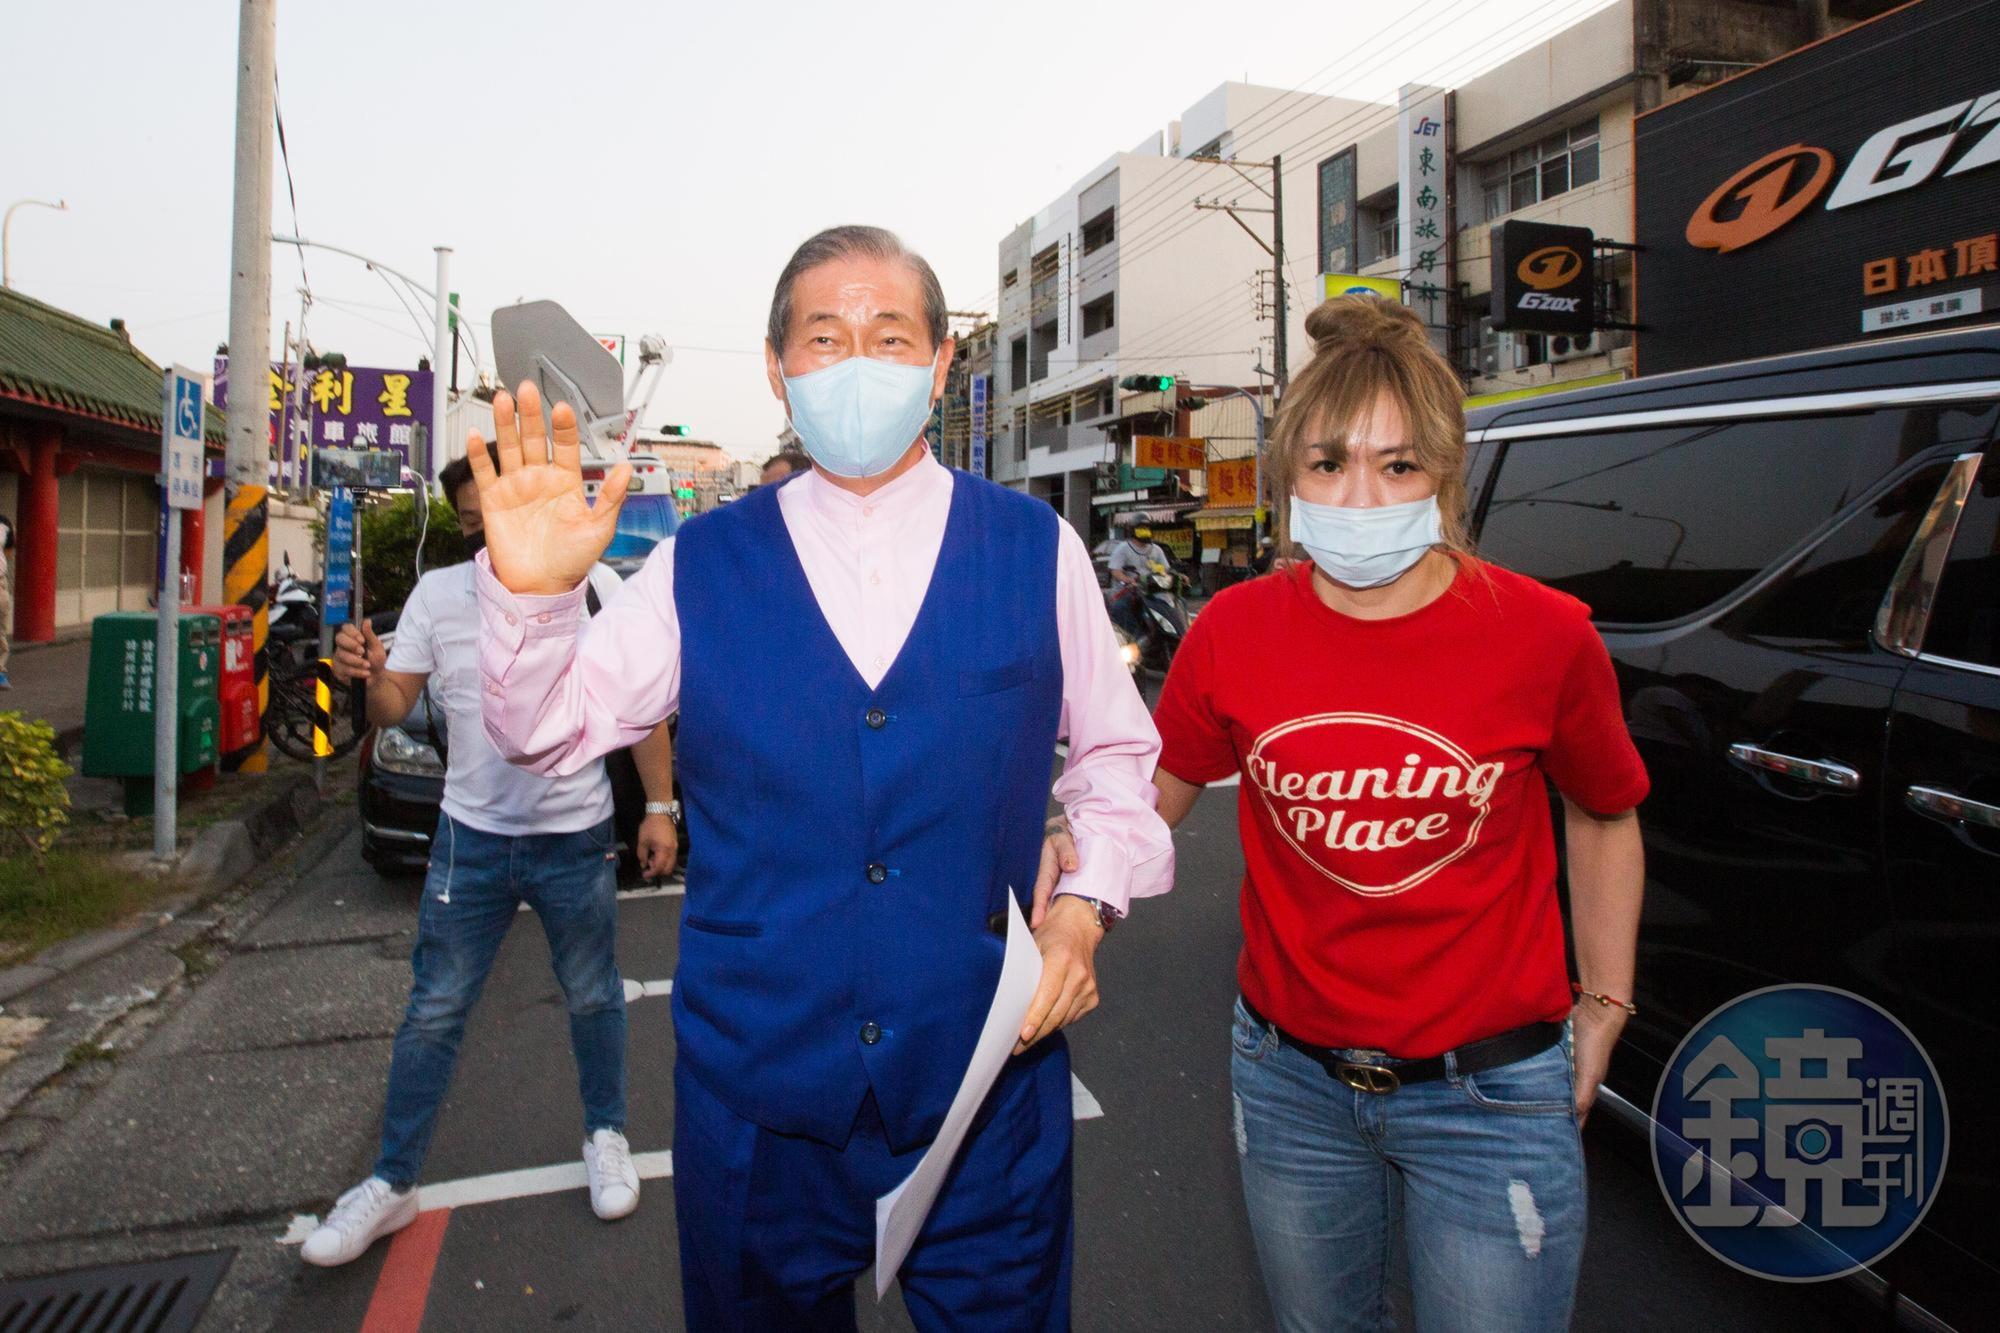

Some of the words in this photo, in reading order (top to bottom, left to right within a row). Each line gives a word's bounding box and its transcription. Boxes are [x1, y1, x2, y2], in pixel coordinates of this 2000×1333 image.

[1413, 117, 1441, 137] SET
[1863, 233, 1999, 296] 日本頂
[1246, 753, 1504, 808] Cleaning
[1287, 806, 1450, 852] Place
